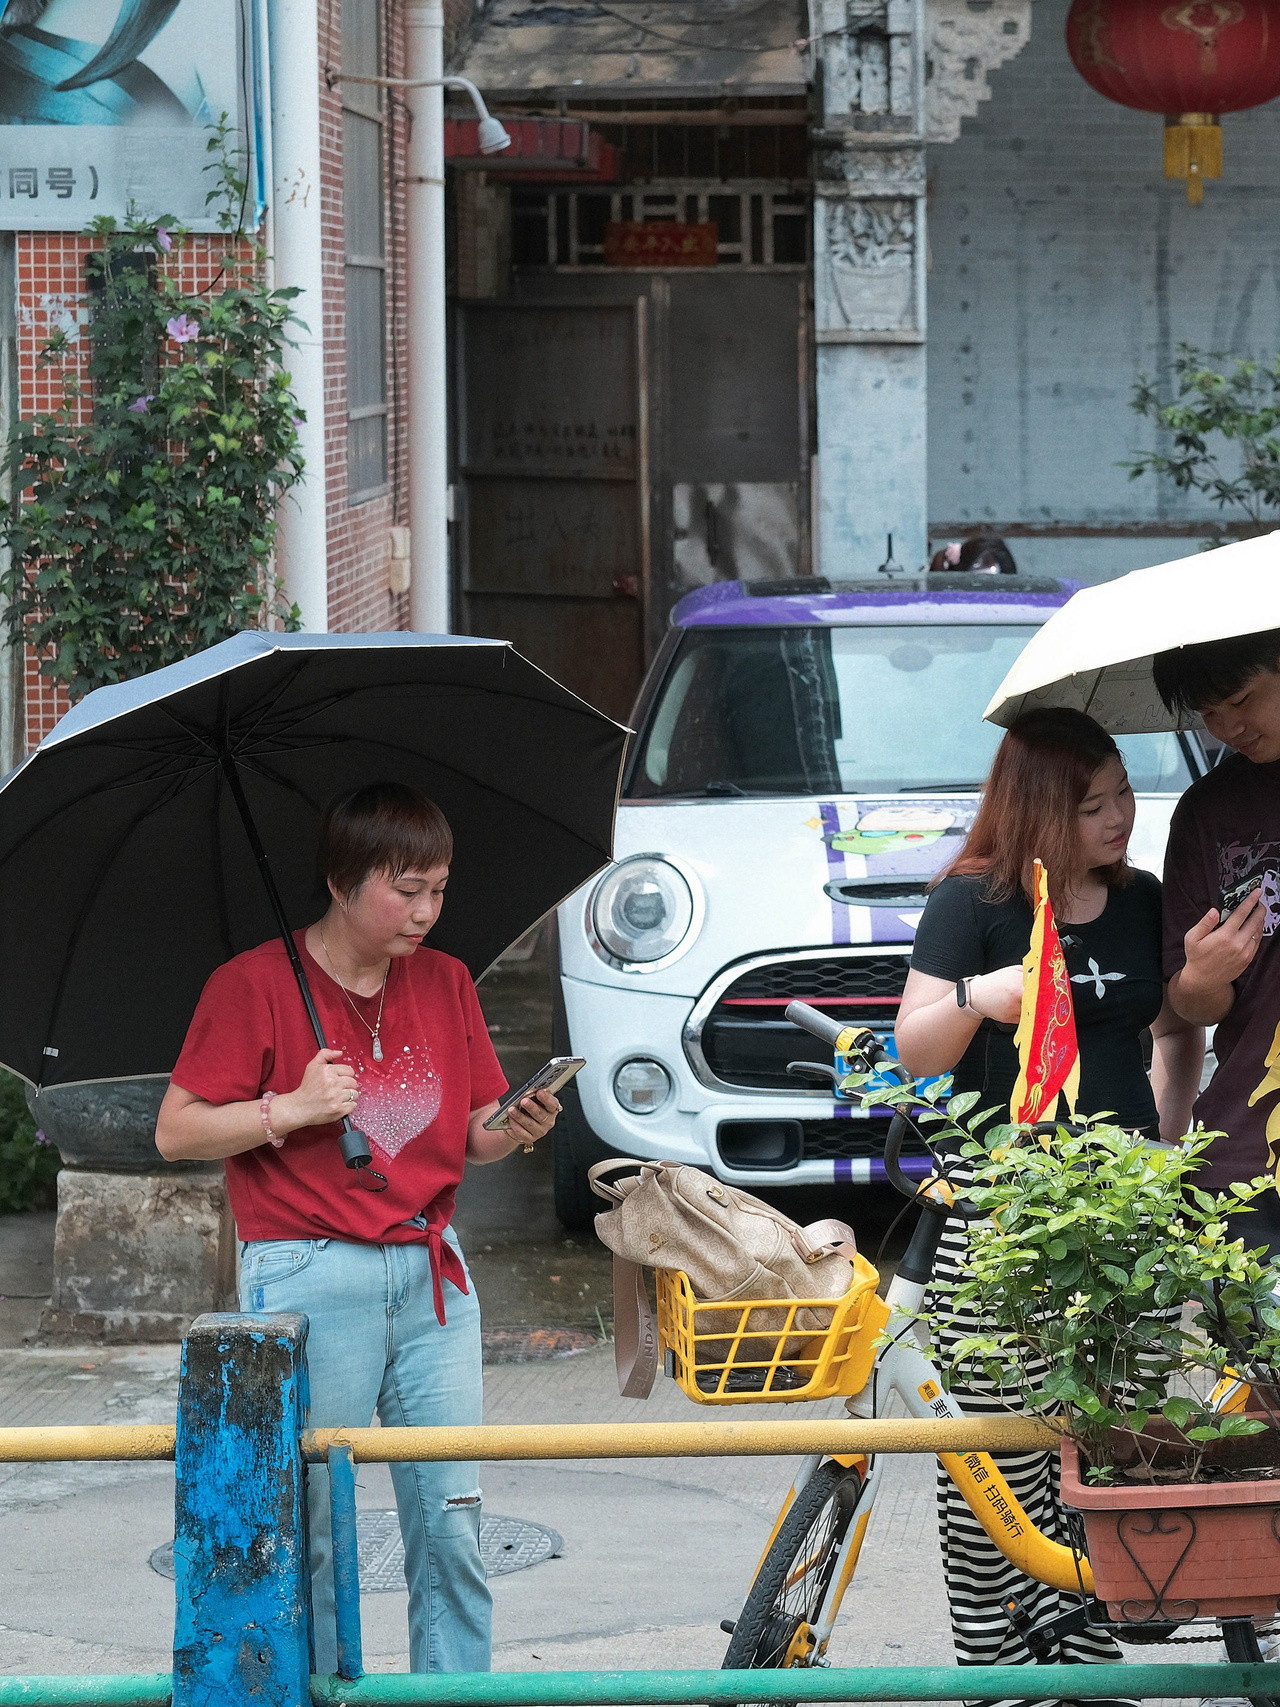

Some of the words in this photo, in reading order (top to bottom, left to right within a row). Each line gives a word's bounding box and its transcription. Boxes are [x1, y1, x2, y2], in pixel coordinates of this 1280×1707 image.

[964, 1453, 990, 1484] 微信
[983, 1484, 1025, 1539] 扫码骑行
